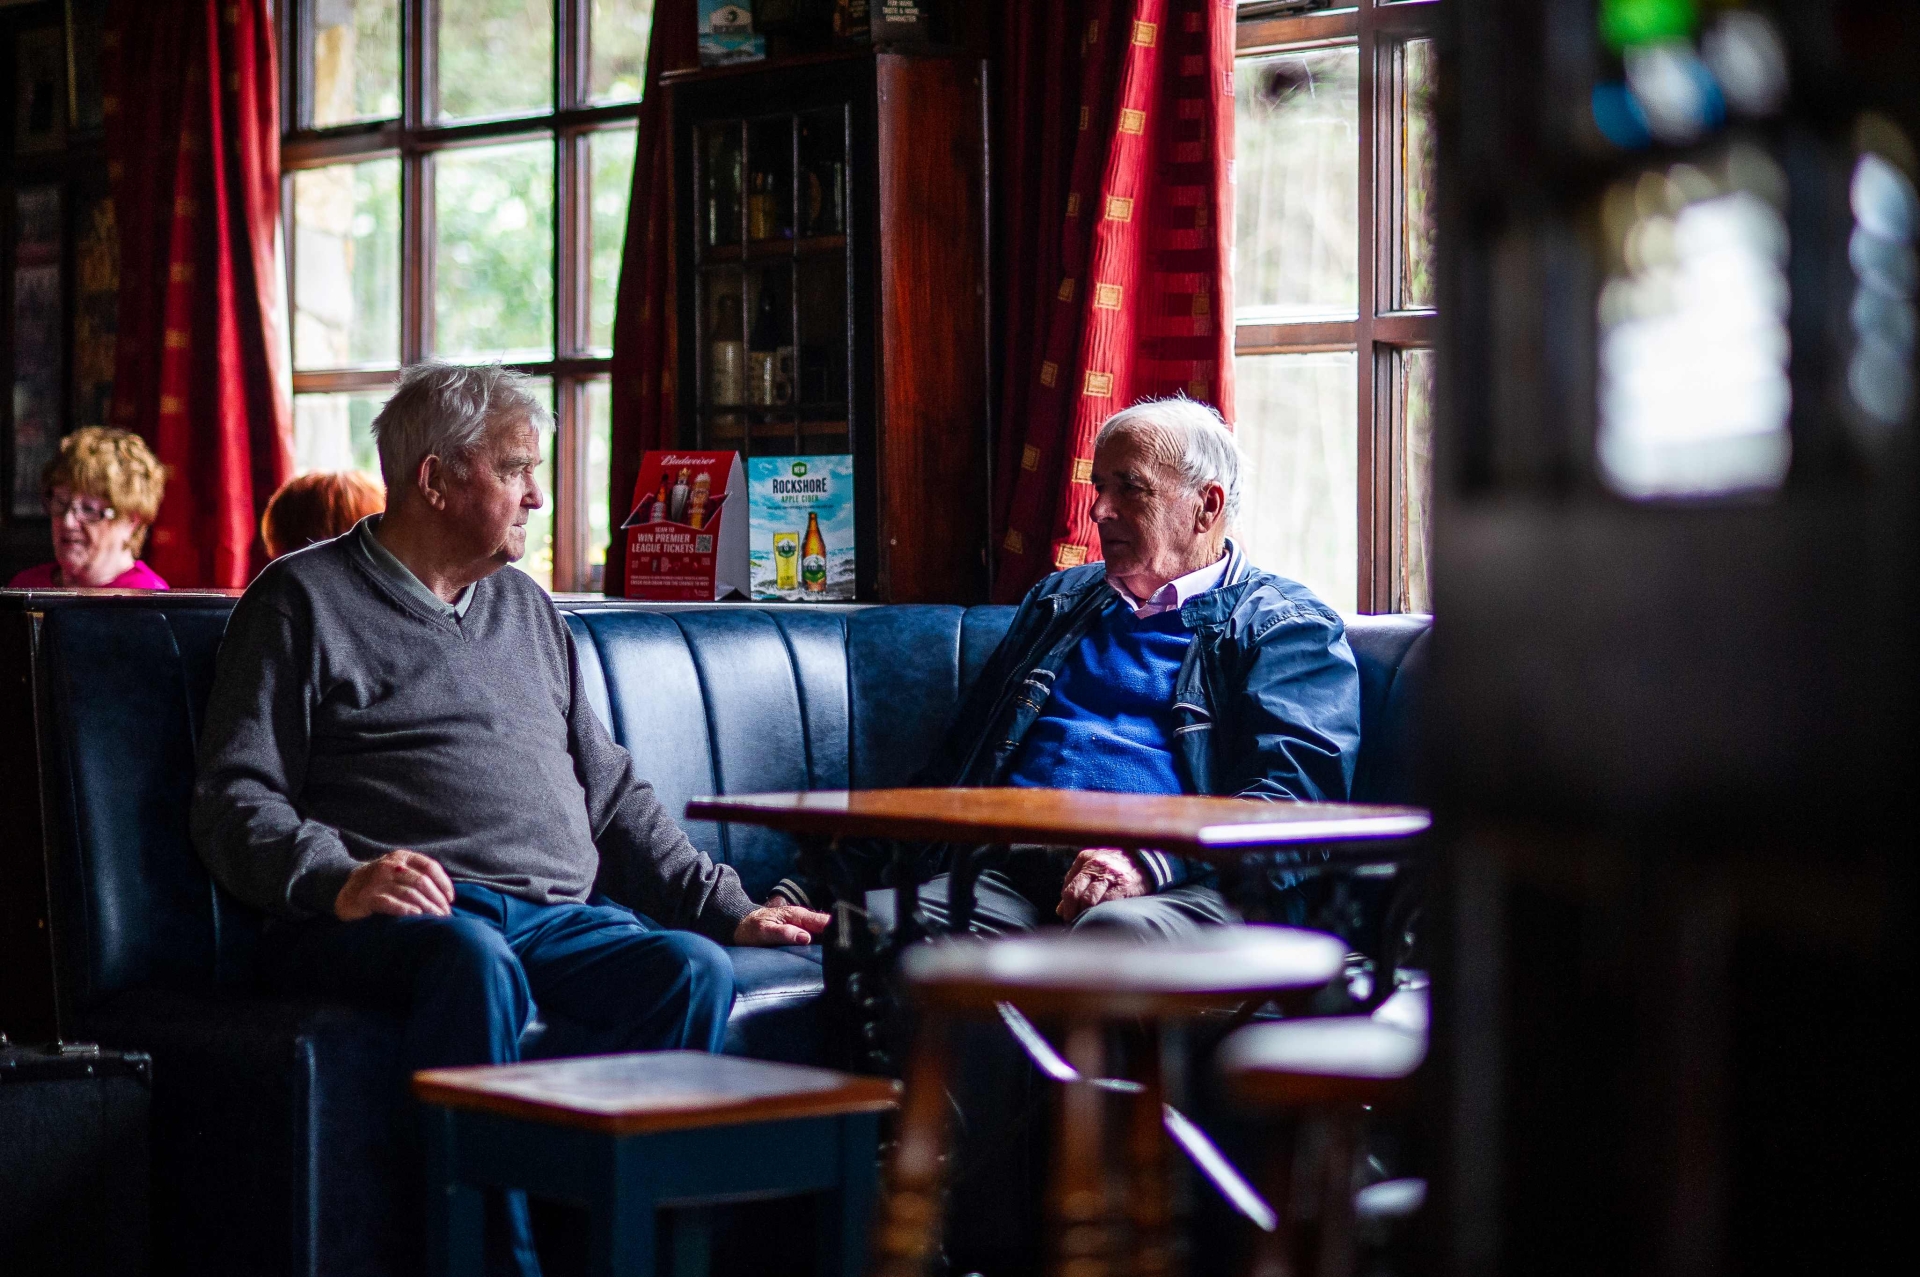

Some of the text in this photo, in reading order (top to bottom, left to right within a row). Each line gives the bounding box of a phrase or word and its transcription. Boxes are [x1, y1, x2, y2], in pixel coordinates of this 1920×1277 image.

[660, 454, 716, 466] Budweiser
[793, 465, 806, 474] NEW
[772, 477, 828, 494] ROCKSHORE
[780, 494, 819, 503] APPLE CIDER
[637, 532, 691, 543] WIN PREMIER
[631, 542, 695, 554] LEAGUE TICKETS
